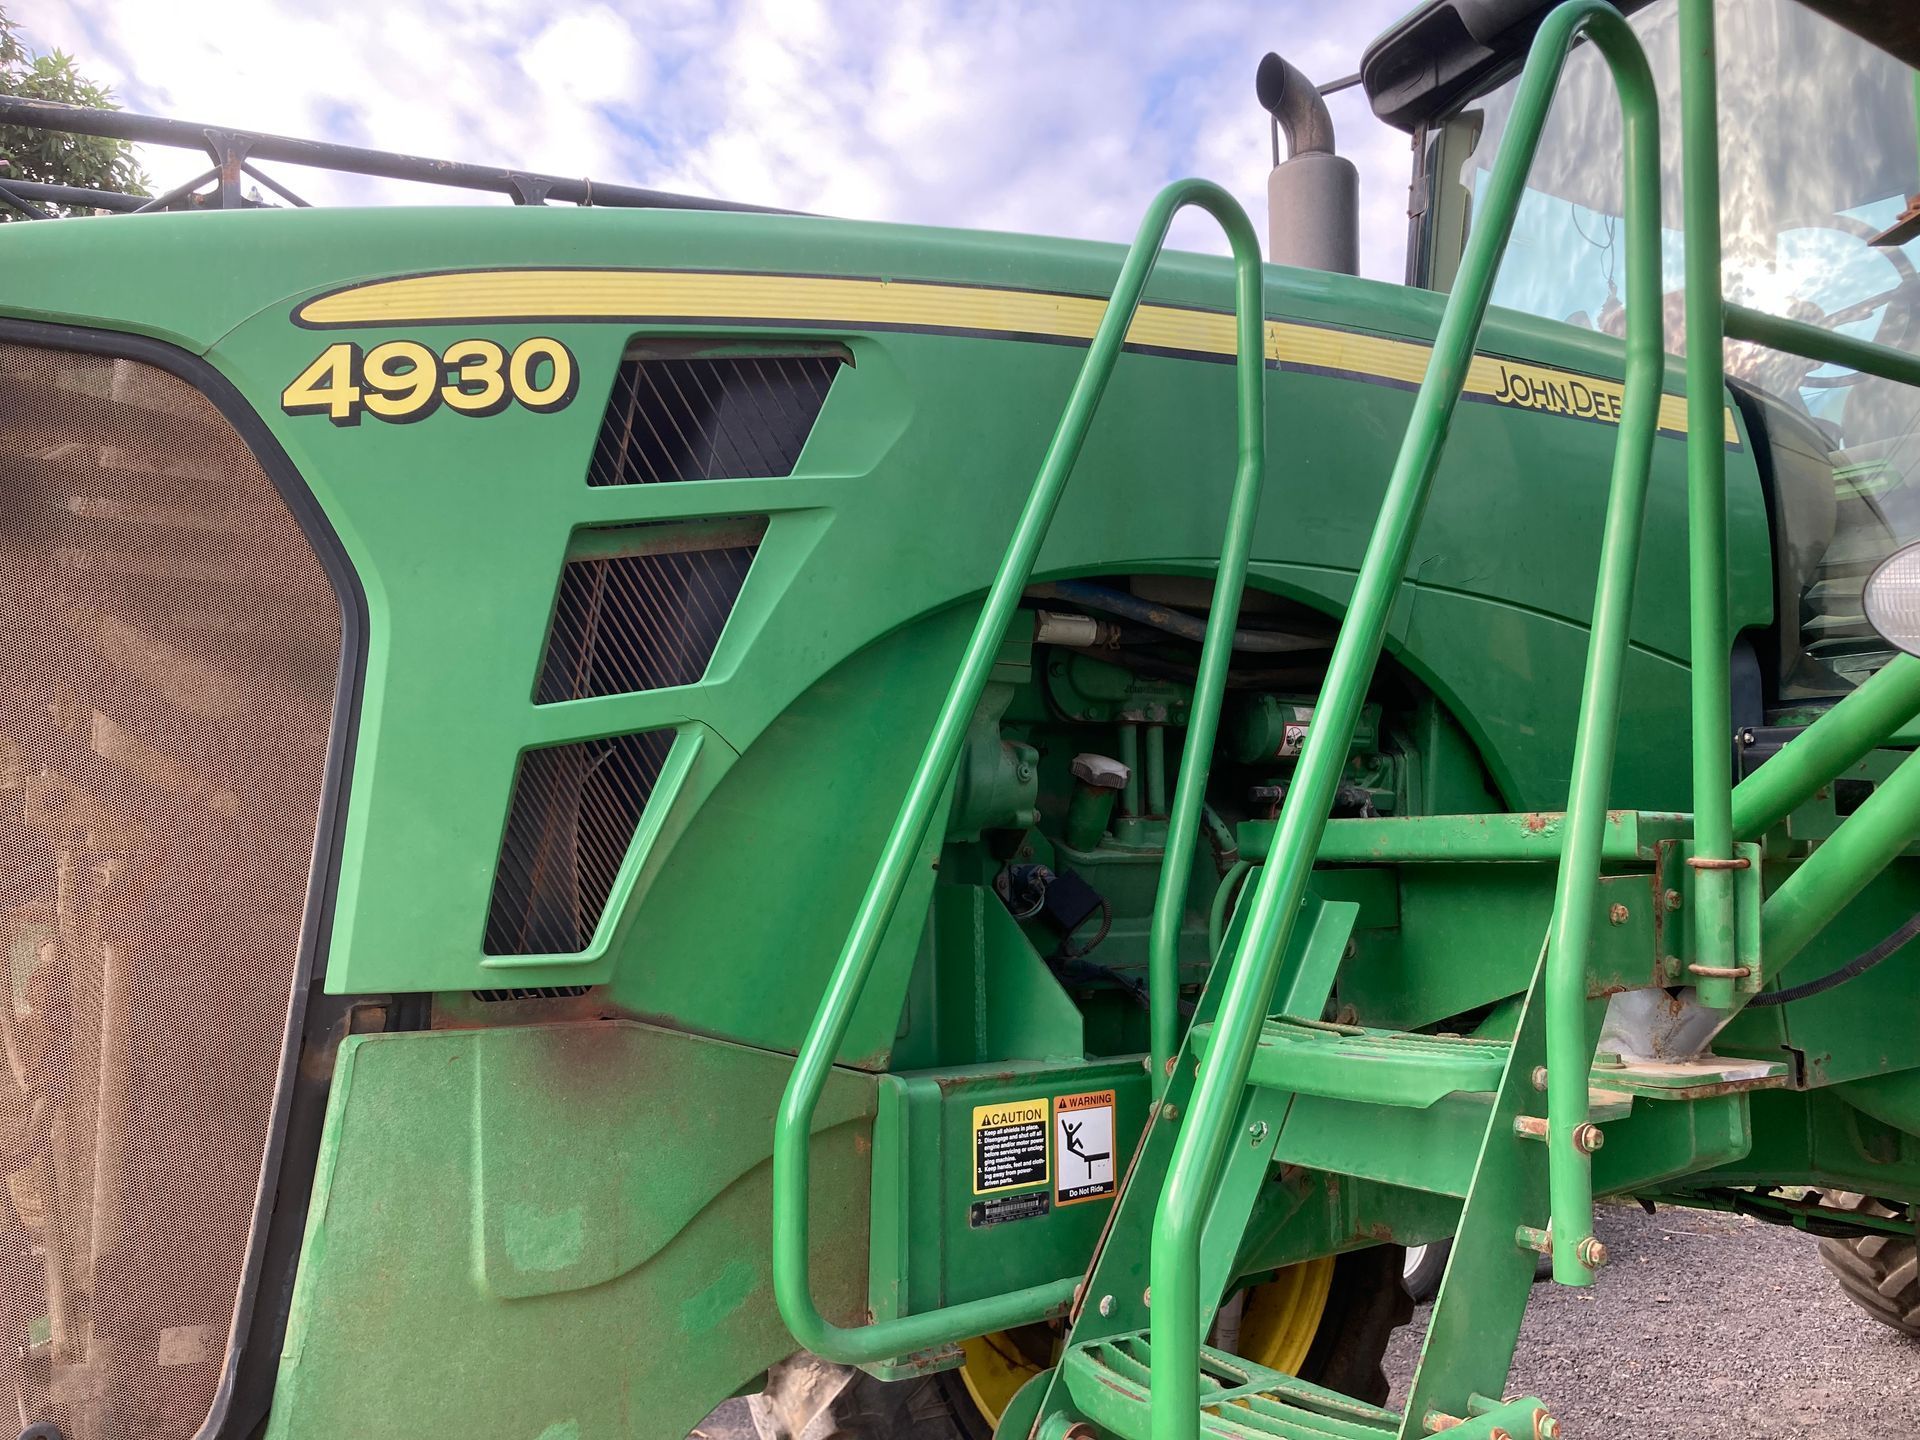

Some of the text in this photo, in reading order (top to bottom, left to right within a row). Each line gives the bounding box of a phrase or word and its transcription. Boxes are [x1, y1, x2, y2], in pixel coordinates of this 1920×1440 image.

[281, 336, 580, 427] 4930
[1495, 365, 1622, 423] JOHN DEE
[1069, 1094, 1111, 1107] WARNING
[992, 1109, 1041, 1125] CAUTION
[984, 1136, 1008, 1144] Disengage
[1000, 1148, 1021, 1156] servicing
[1069, 1189, 1078, 1197] Do
[1079, 1187, 1089, 1195] Not
[1090, 1185, 1104, 1193] Ride
